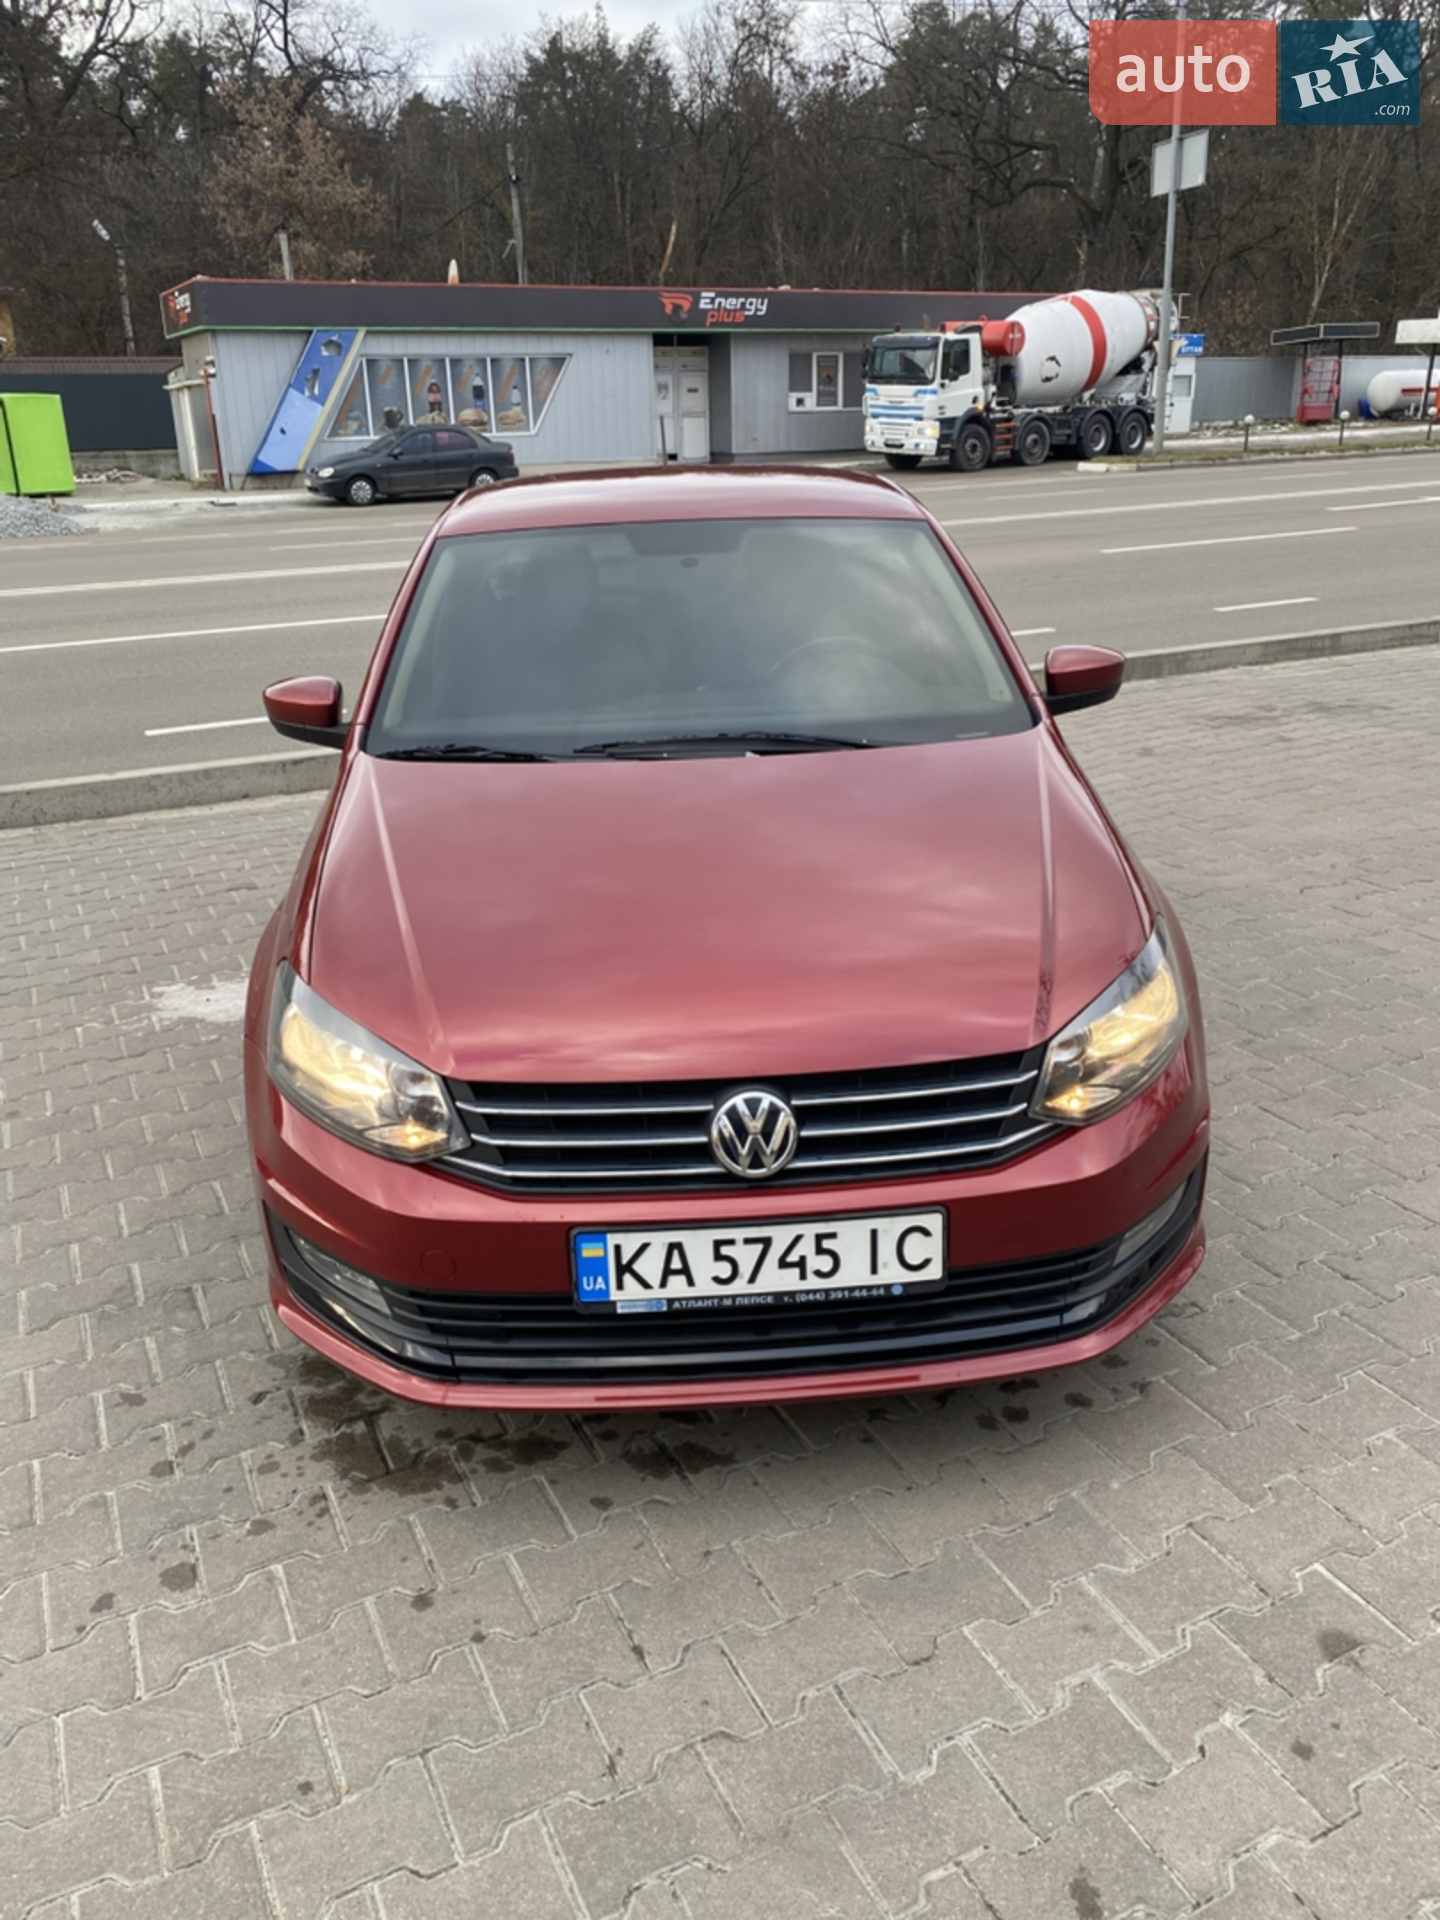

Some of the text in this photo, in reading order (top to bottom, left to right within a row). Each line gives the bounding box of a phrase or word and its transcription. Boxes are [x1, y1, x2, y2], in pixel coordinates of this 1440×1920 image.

[699, 291, 768, 315] Energy
[705, 307, 746, 327] plus
[613, 1224, 934, 1292] KA 5745 IC
[582, 1276, 607, 1292] UA
[672, 1297, 733, 1310] АТЛАНТ-М
[795, 1290, 826, 1303] (044)
[828, 1286, 886, 1300] 391-44-44
